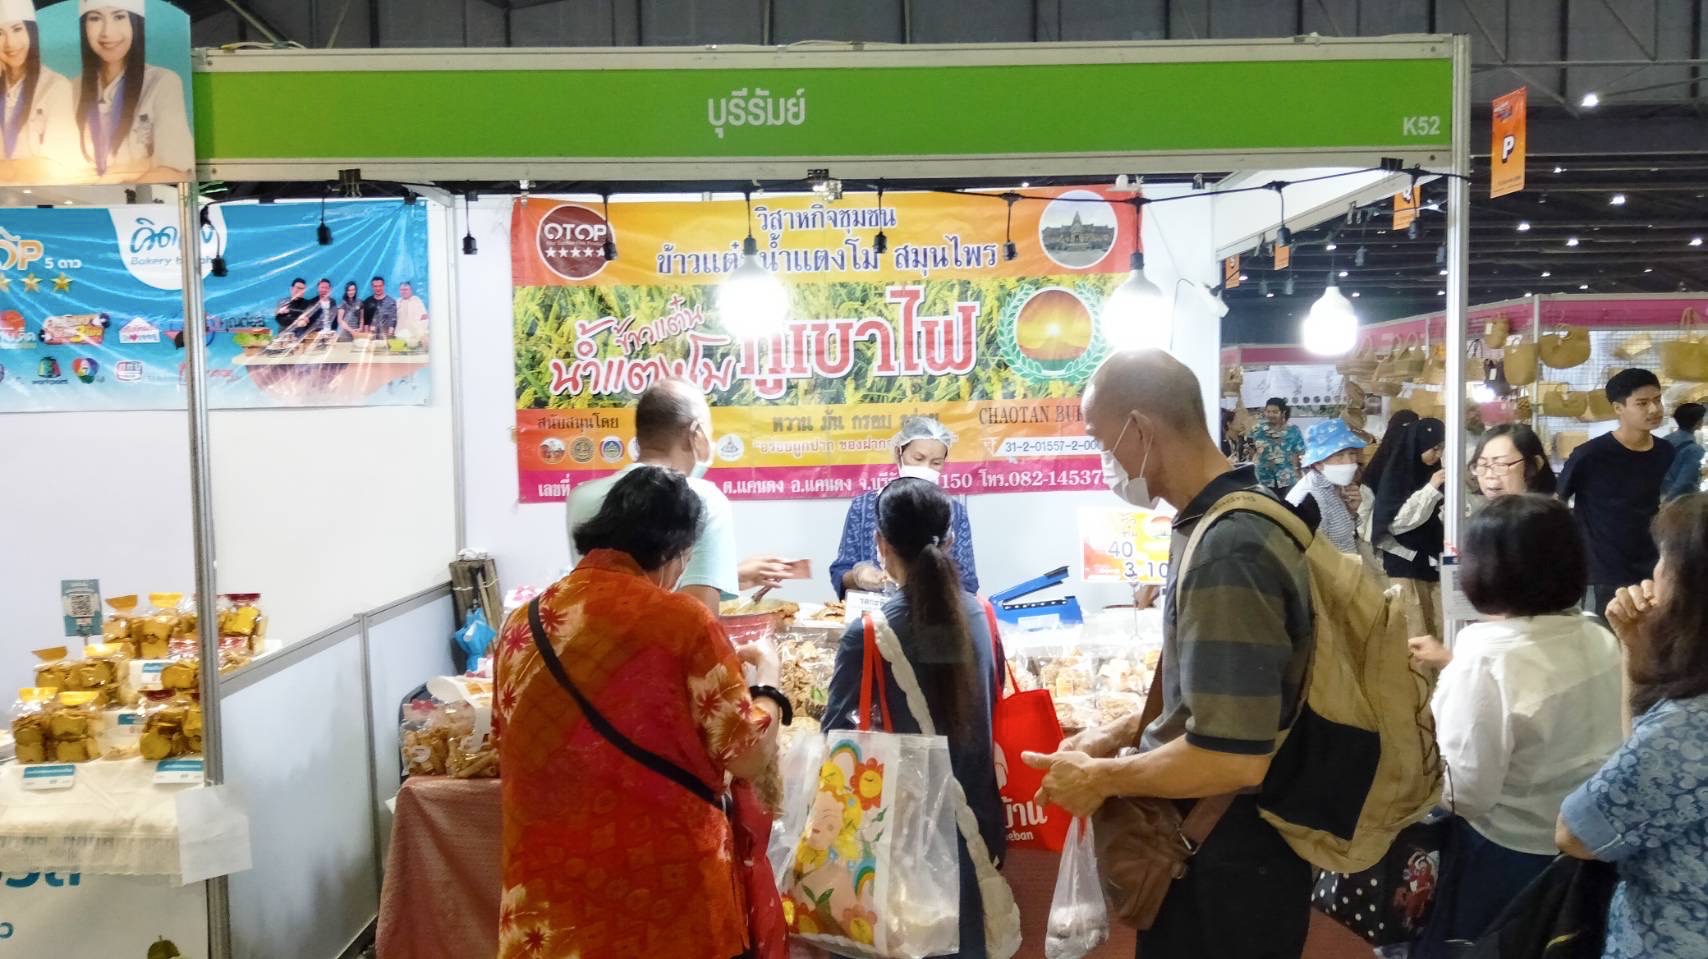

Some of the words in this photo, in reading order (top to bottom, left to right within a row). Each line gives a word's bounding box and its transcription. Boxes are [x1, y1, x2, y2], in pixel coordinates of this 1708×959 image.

[707, 87, 806, 139] บุรีรัมย์
[1402, 115, 1441, 136] K52
[1502, 135, 1515, 162] P
[754, 203, 897, 233] วิสาหกิจชุมชน
[543, 222, 608, 242] OTOP
[44, 257, 54, 269] 5
[657, 233, 880, 274] ข้าวแต๋น้ำแตงโม
[894, 236, 998, 276] สมุนไพร
[739, 286, 980, 399] ภูเขาไฟ
[537, 412, 620, 433] สนับสนุนโดย
[979, 406, 1050, 425] CHAOTAN
[538, 473, 571, 497] เลขที่
[979, 469, 1105, 489] โทร.082-14537
[1108, 540, 1134, 558] 40
[1006, 831, 1034, 841] eban
